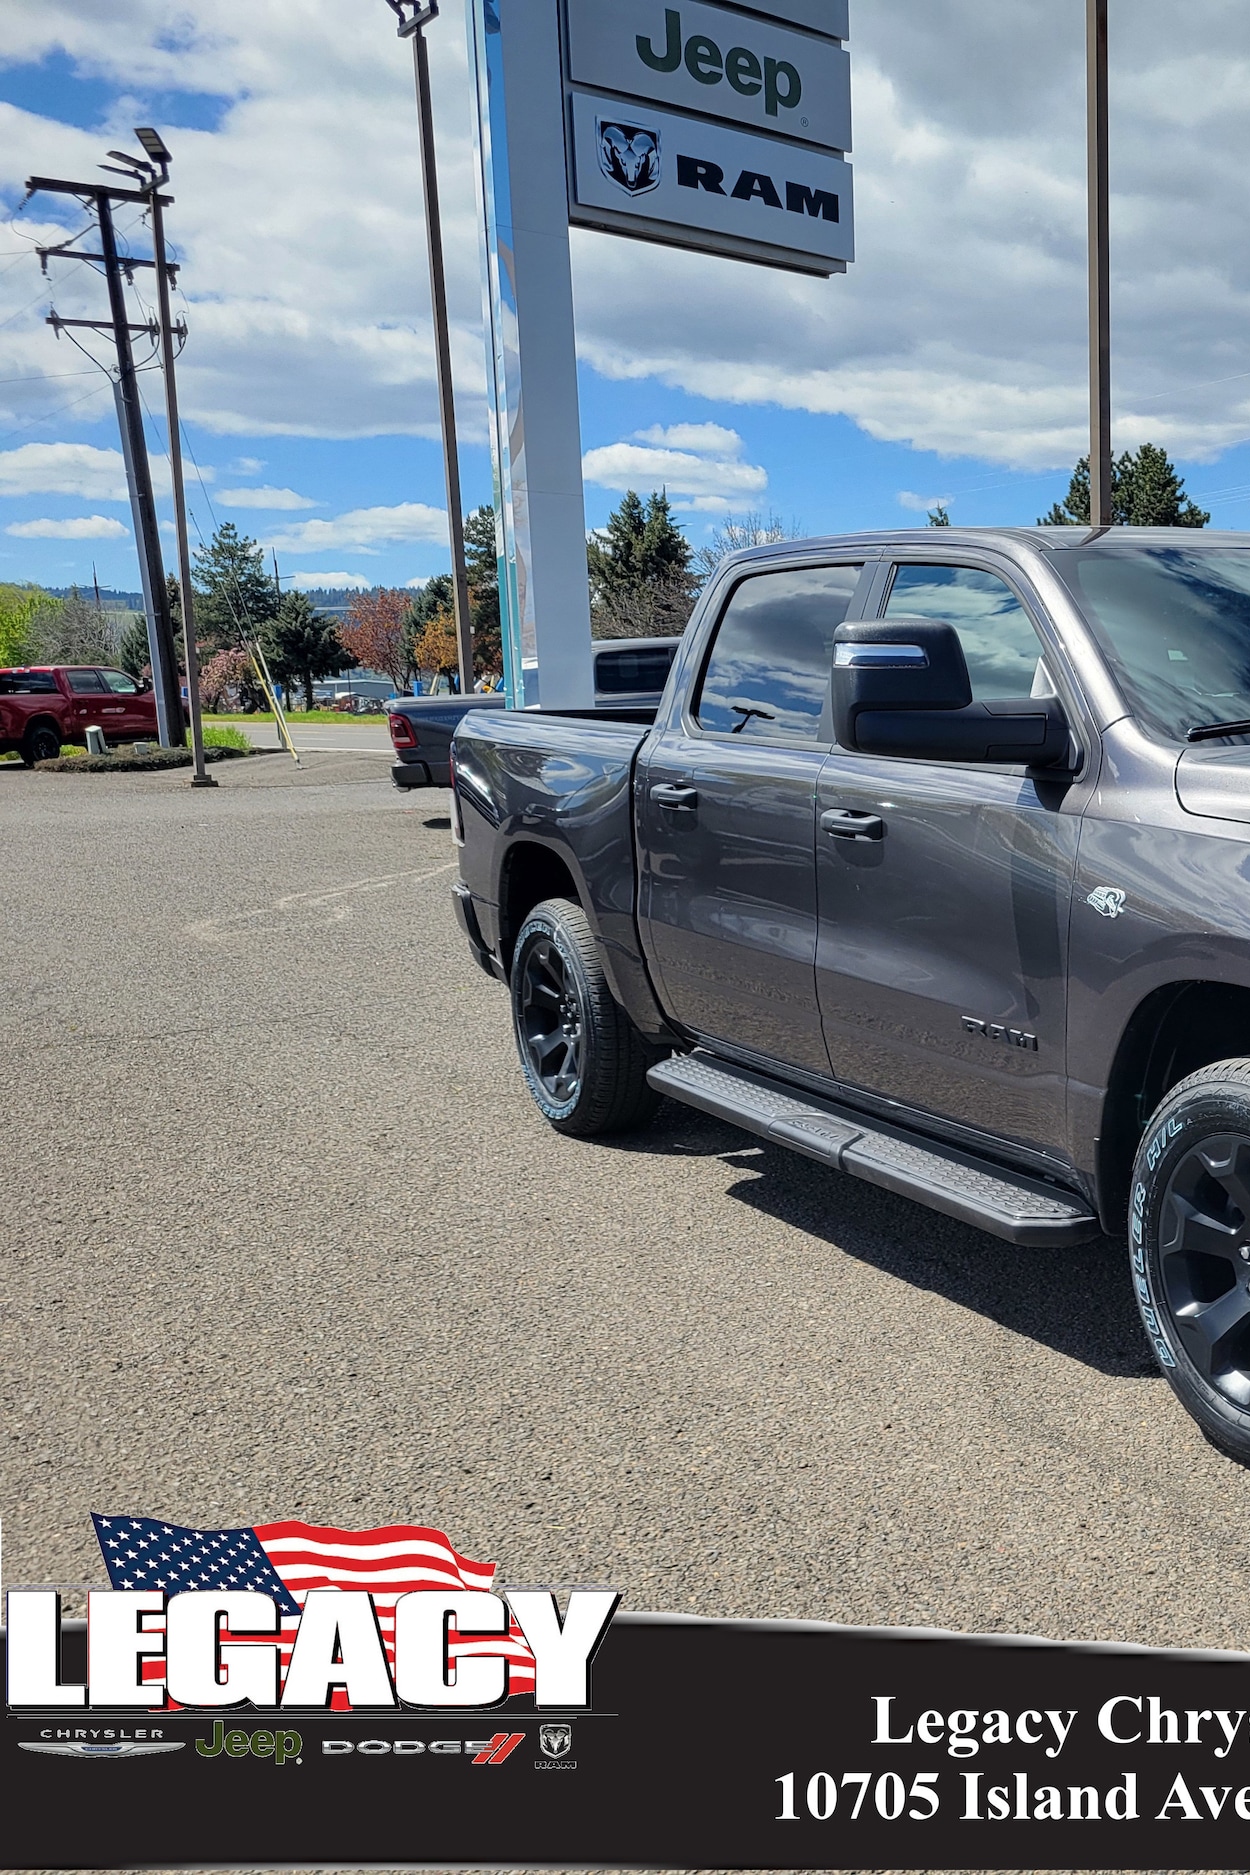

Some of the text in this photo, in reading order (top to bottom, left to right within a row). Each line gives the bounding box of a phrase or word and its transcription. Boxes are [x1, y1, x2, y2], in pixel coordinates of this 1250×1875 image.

[635, 8, 802, 117] Jeep
[676, 154, 840, 223] RAM
[961, 1015, 1039, 1051] RAM
[1132, 1182, 1176, 1368] DUELER
